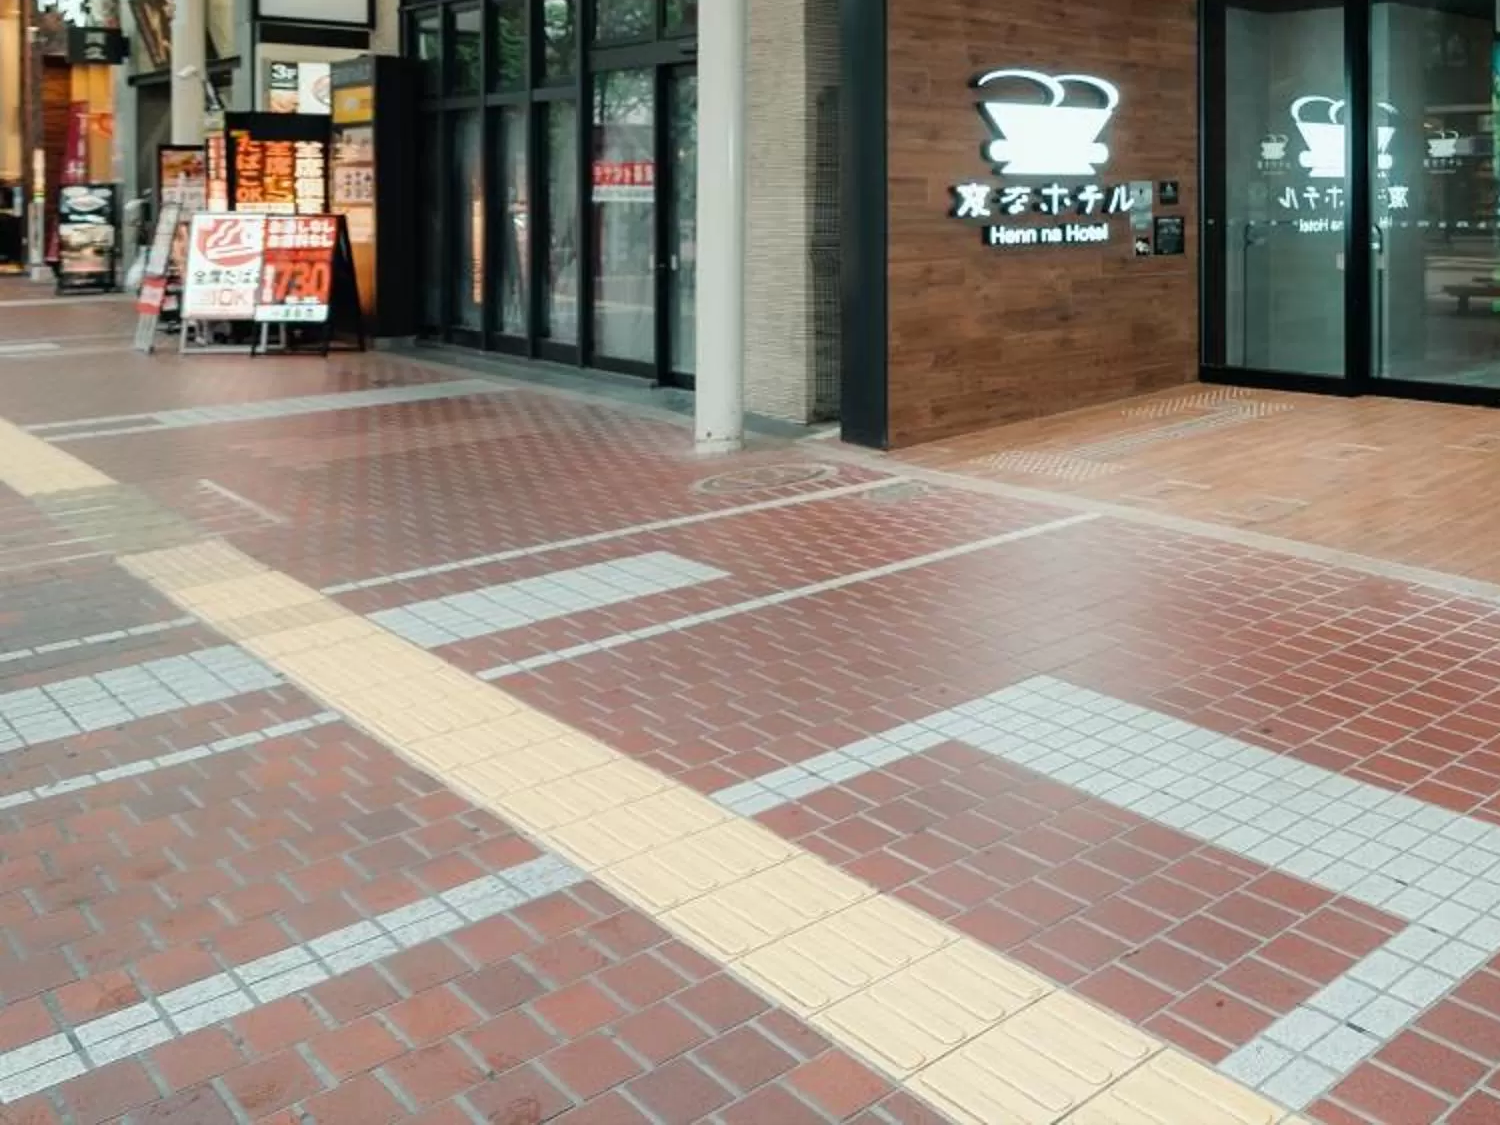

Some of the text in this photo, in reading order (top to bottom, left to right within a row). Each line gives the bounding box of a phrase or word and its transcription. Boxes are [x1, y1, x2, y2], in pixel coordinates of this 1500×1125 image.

[271, 64, 297, 80] 3F
[957, 183, 1136, 218] 変なホテル
[989, 223, 1110, 245] Henn na Hotel
